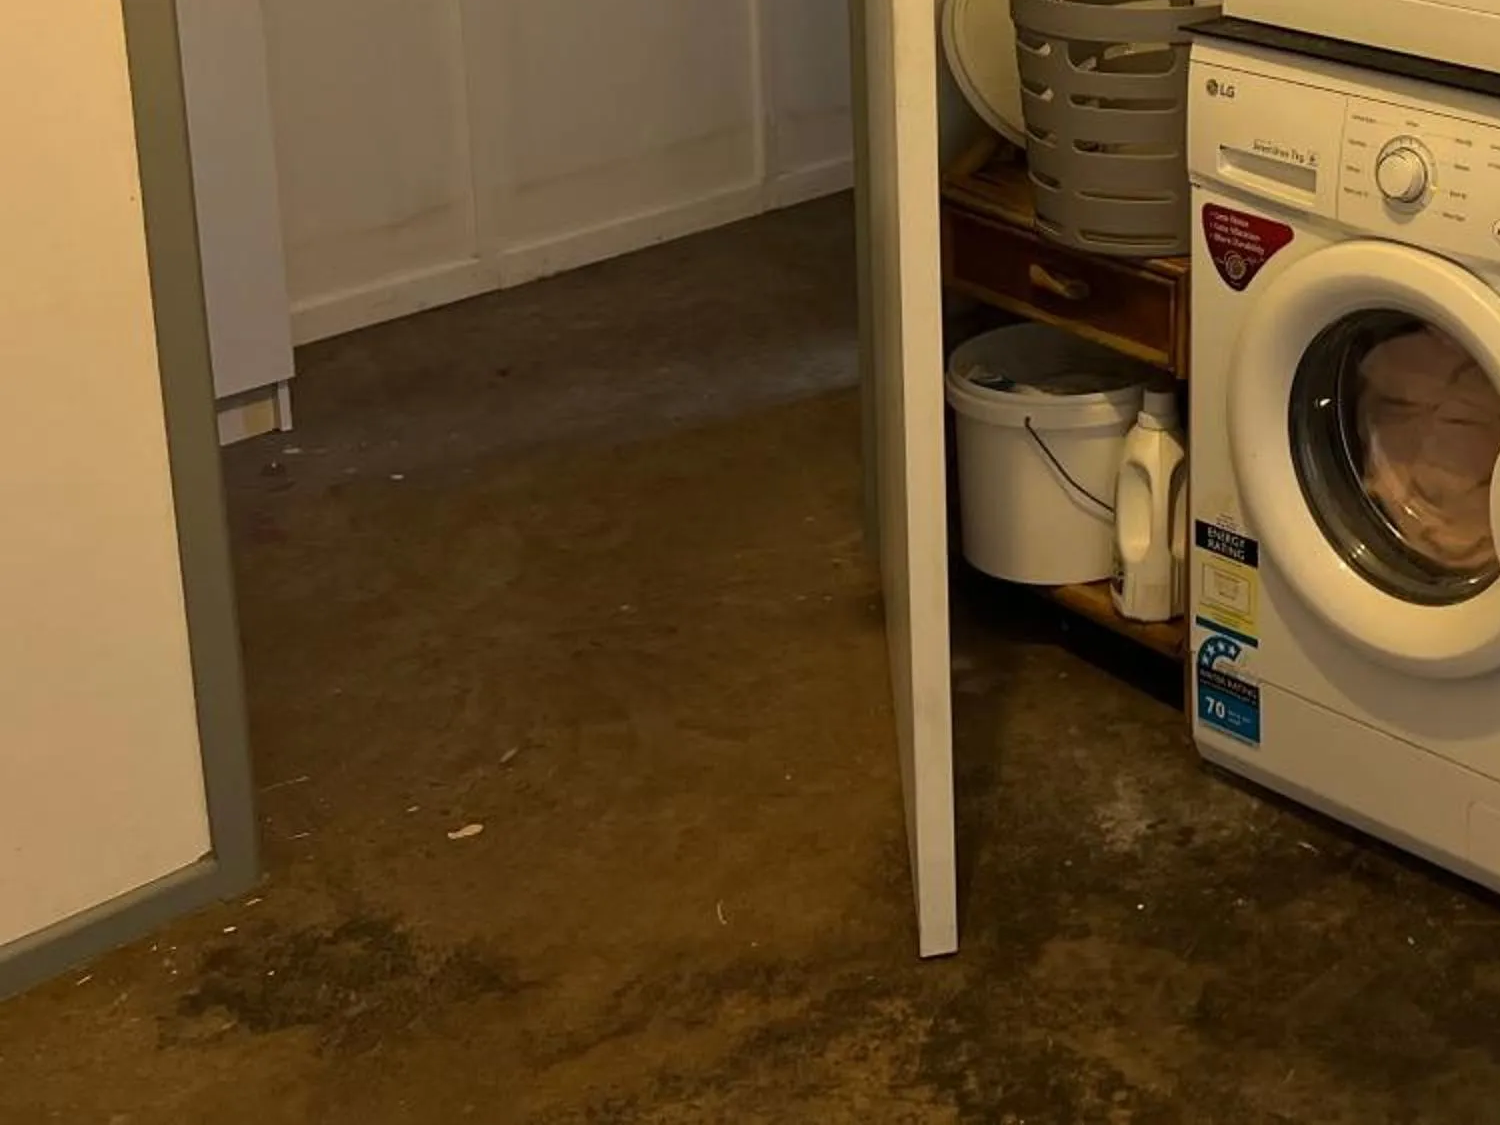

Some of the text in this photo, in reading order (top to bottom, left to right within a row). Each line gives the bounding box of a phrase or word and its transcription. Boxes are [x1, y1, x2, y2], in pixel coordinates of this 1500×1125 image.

[1219, 83, 1236, 98] LG
[1207, 538, 1246, 561] RATING
[1205, 695, 1226, 719] 70
